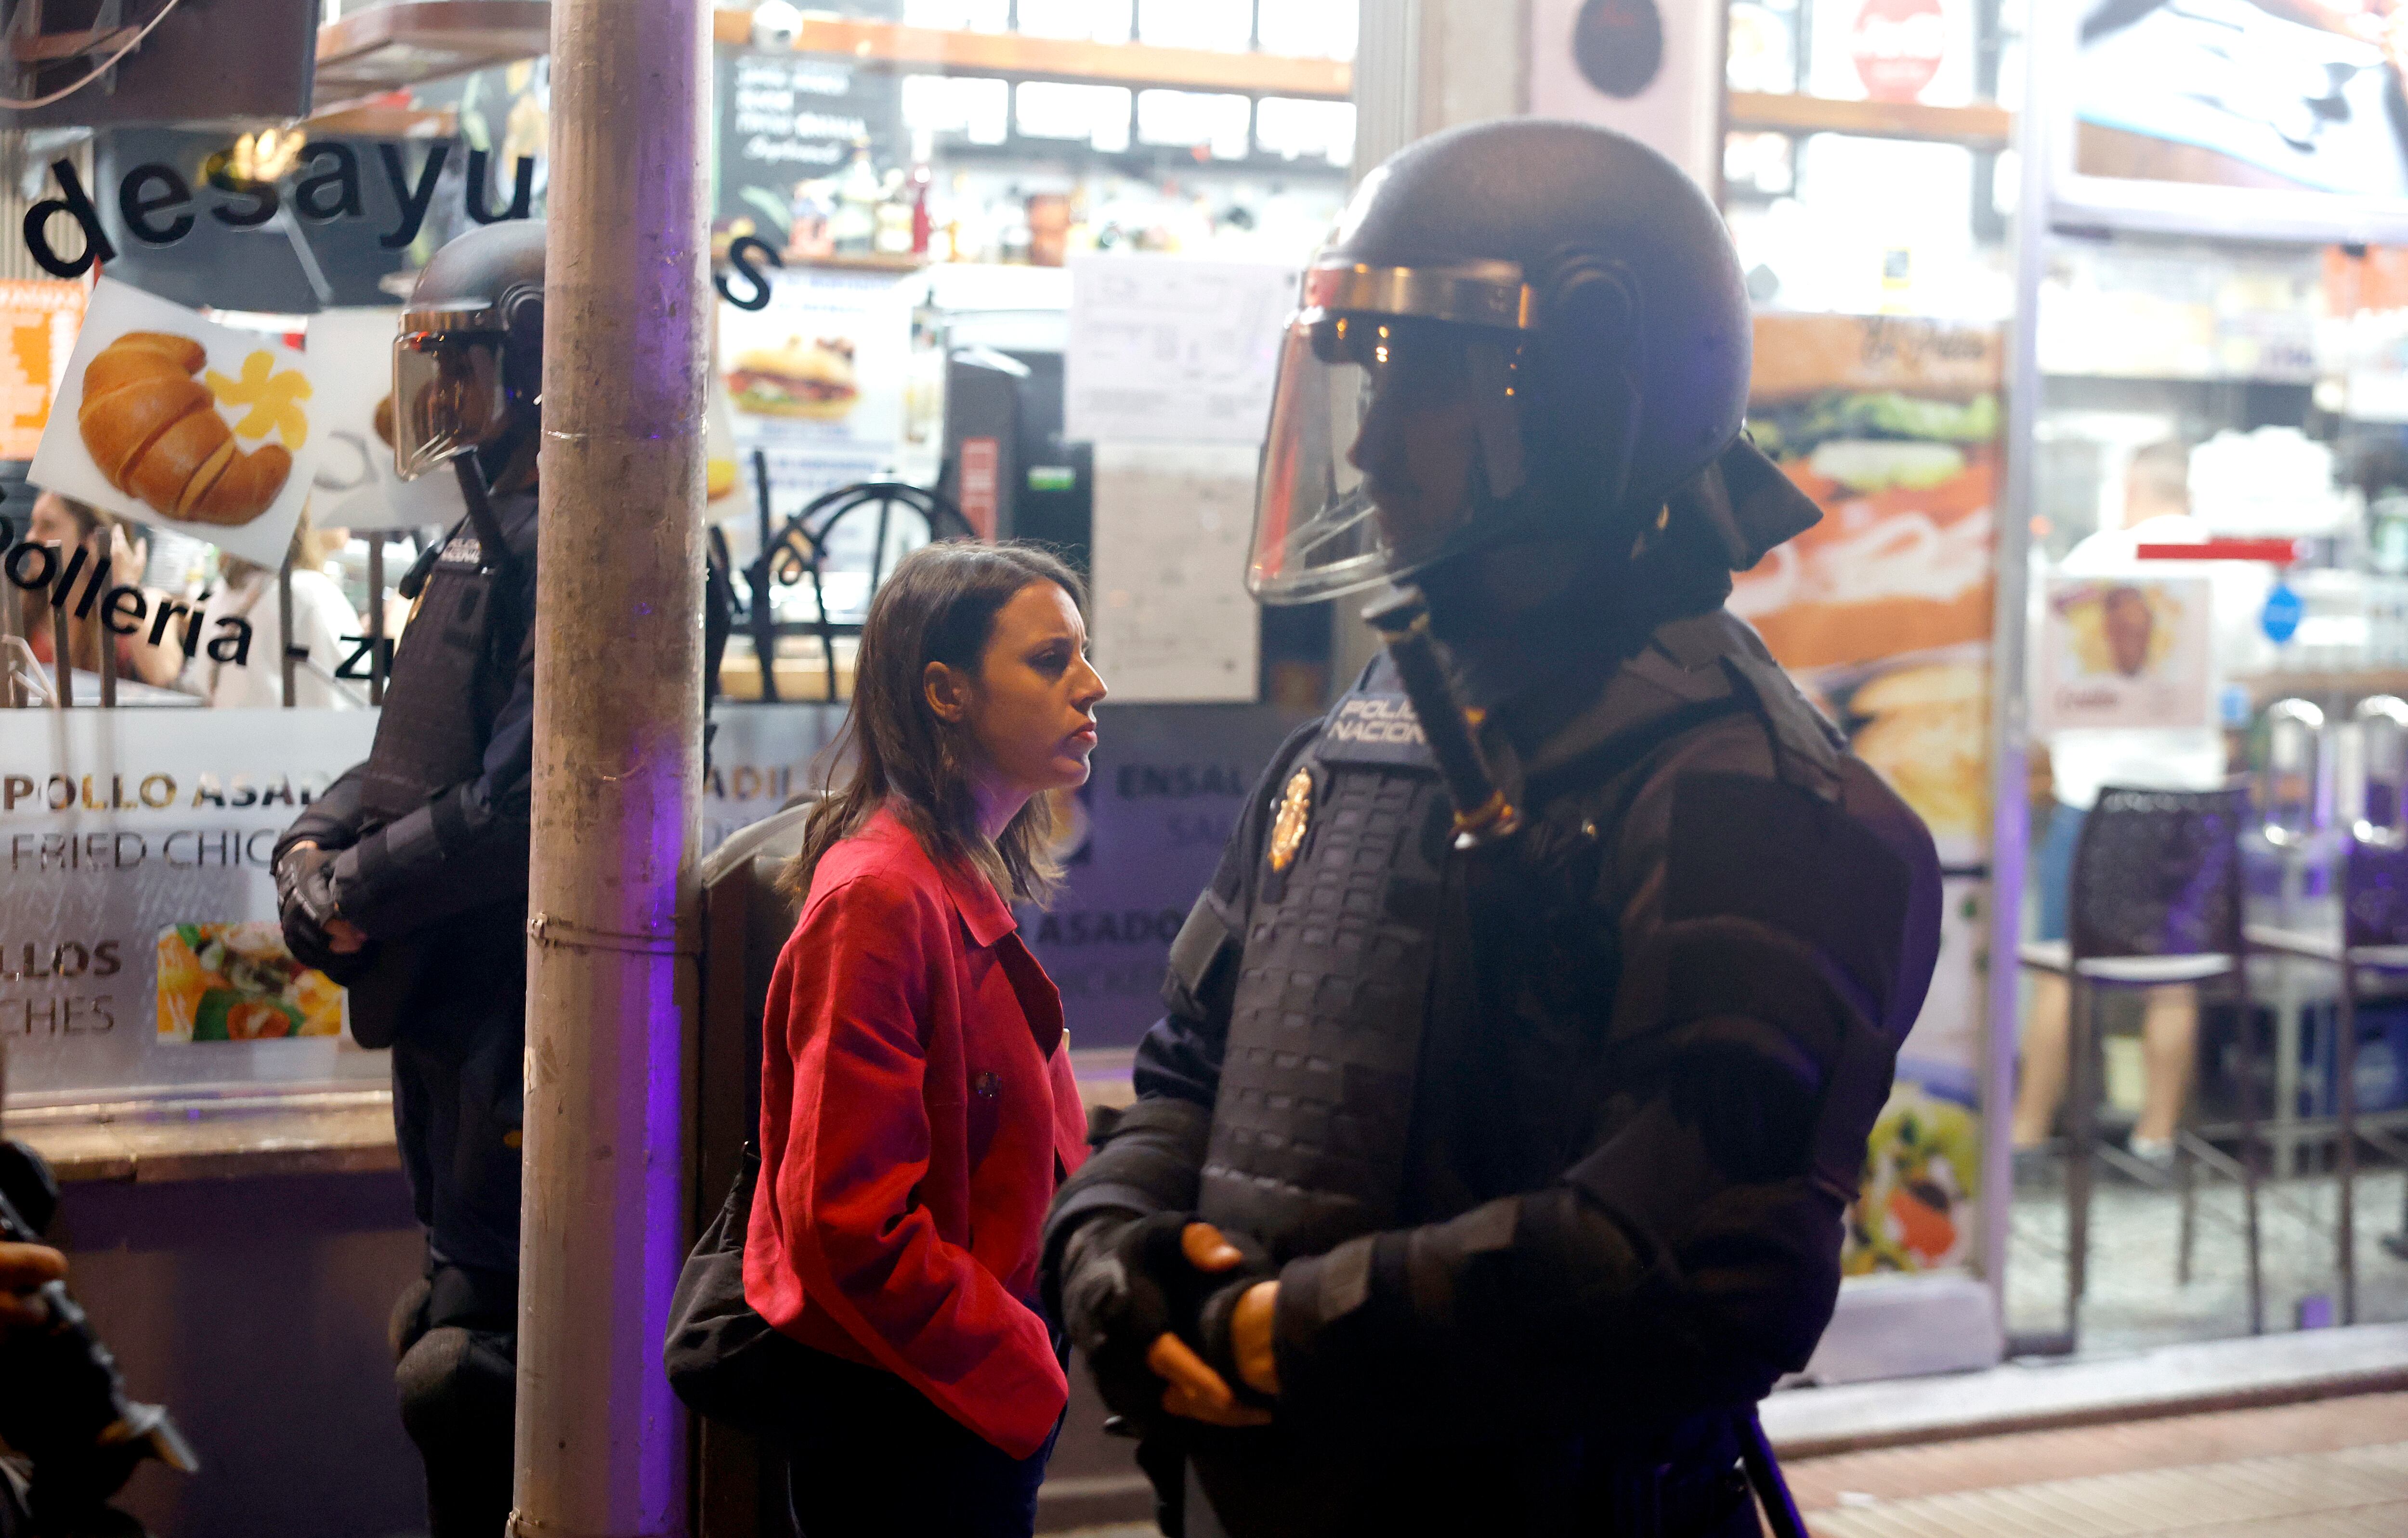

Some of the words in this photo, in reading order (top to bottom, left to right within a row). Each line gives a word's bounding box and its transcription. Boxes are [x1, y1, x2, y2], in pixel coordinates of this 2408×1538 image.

[4, 772, 177, 810] POLLO
[12, 832, 146, 870] FRIED
[163, 828, 284, 868] CHIC
